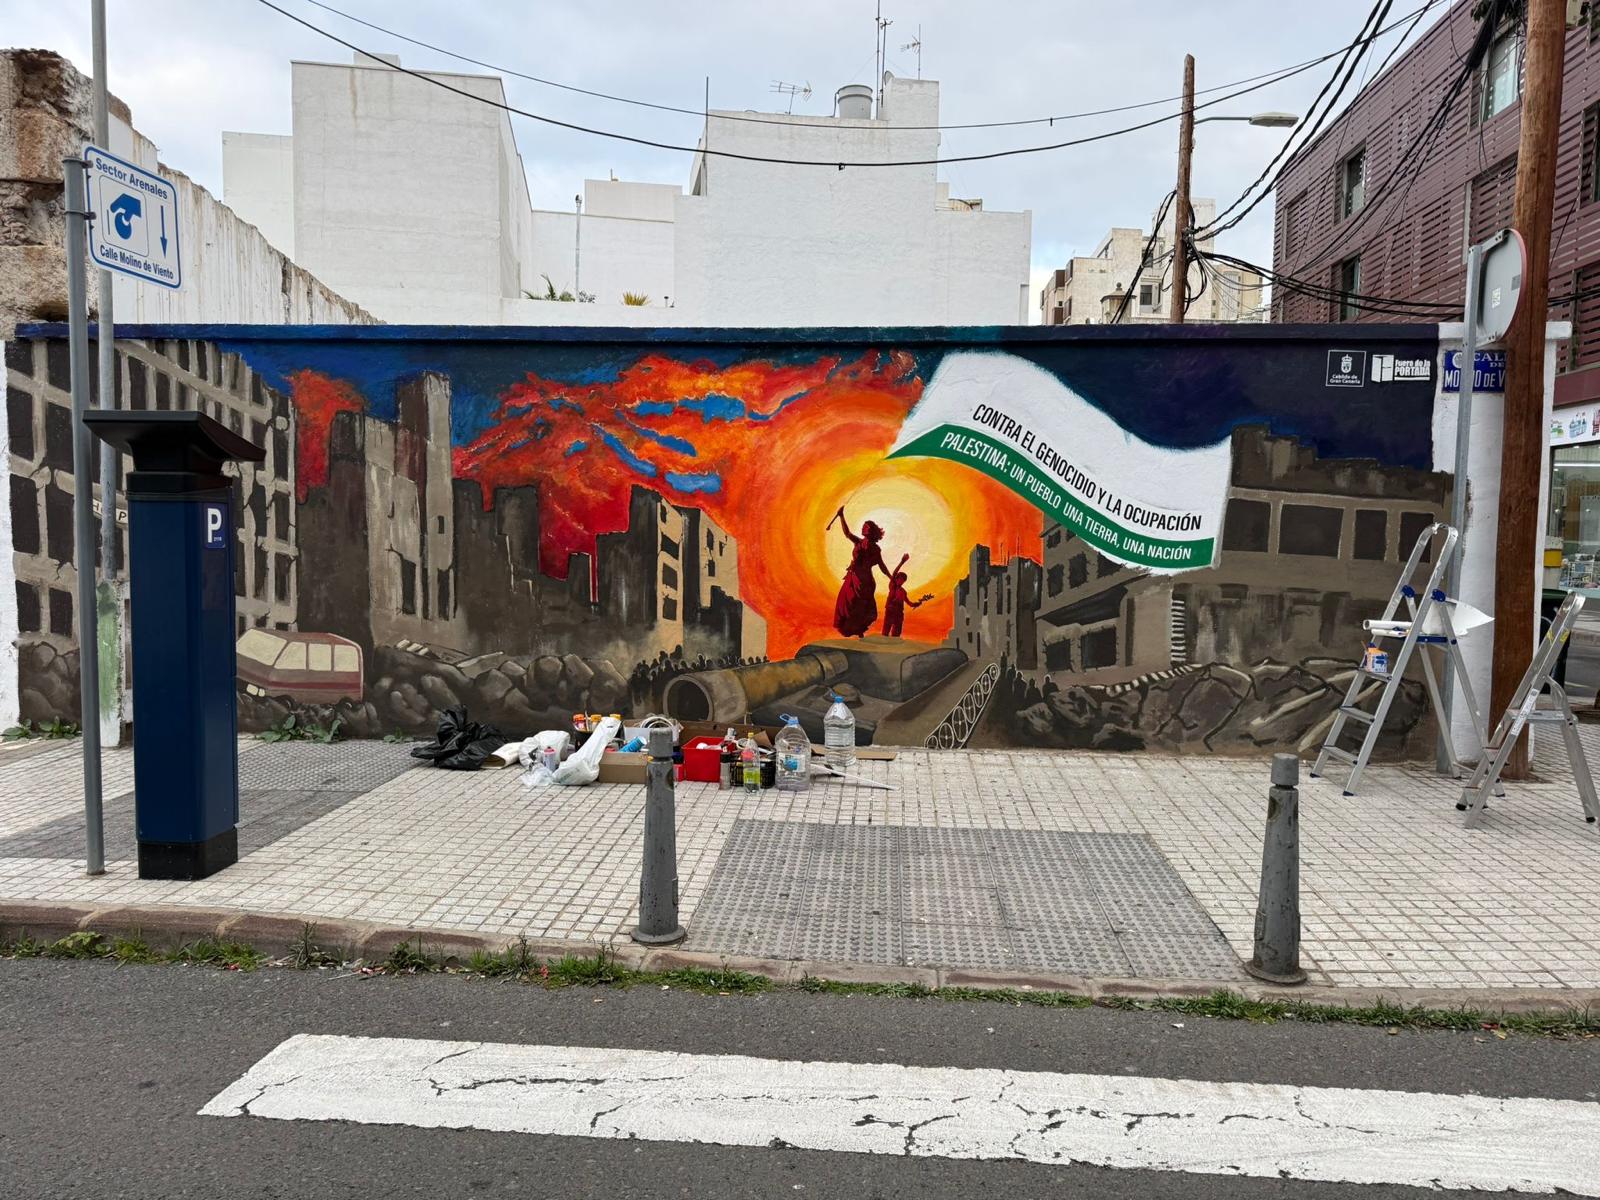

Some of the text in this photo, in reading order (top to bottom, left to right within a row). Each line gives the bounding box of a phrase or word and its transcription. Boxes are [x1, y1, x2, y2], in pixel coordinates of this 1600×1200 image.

[95, 157, 168, 199] Sector Arenales
[100, 244, 174, 279] Calle Molino de Viento
[1394, 366, 1431, 376] PORTADA
[1444, 370, 1482, 387] MOO
[1483, 373, 1496, 387] DE
[972, 404, 1202, 531] CONTRA EL GENOCIDIO Y LA OCUPACIÓN
[940, 432, 1192, 560] PALESTINA: UN PUEBLO UNA TIERRA, UNA NACIÓN
[207, 508, 222, 543] P
